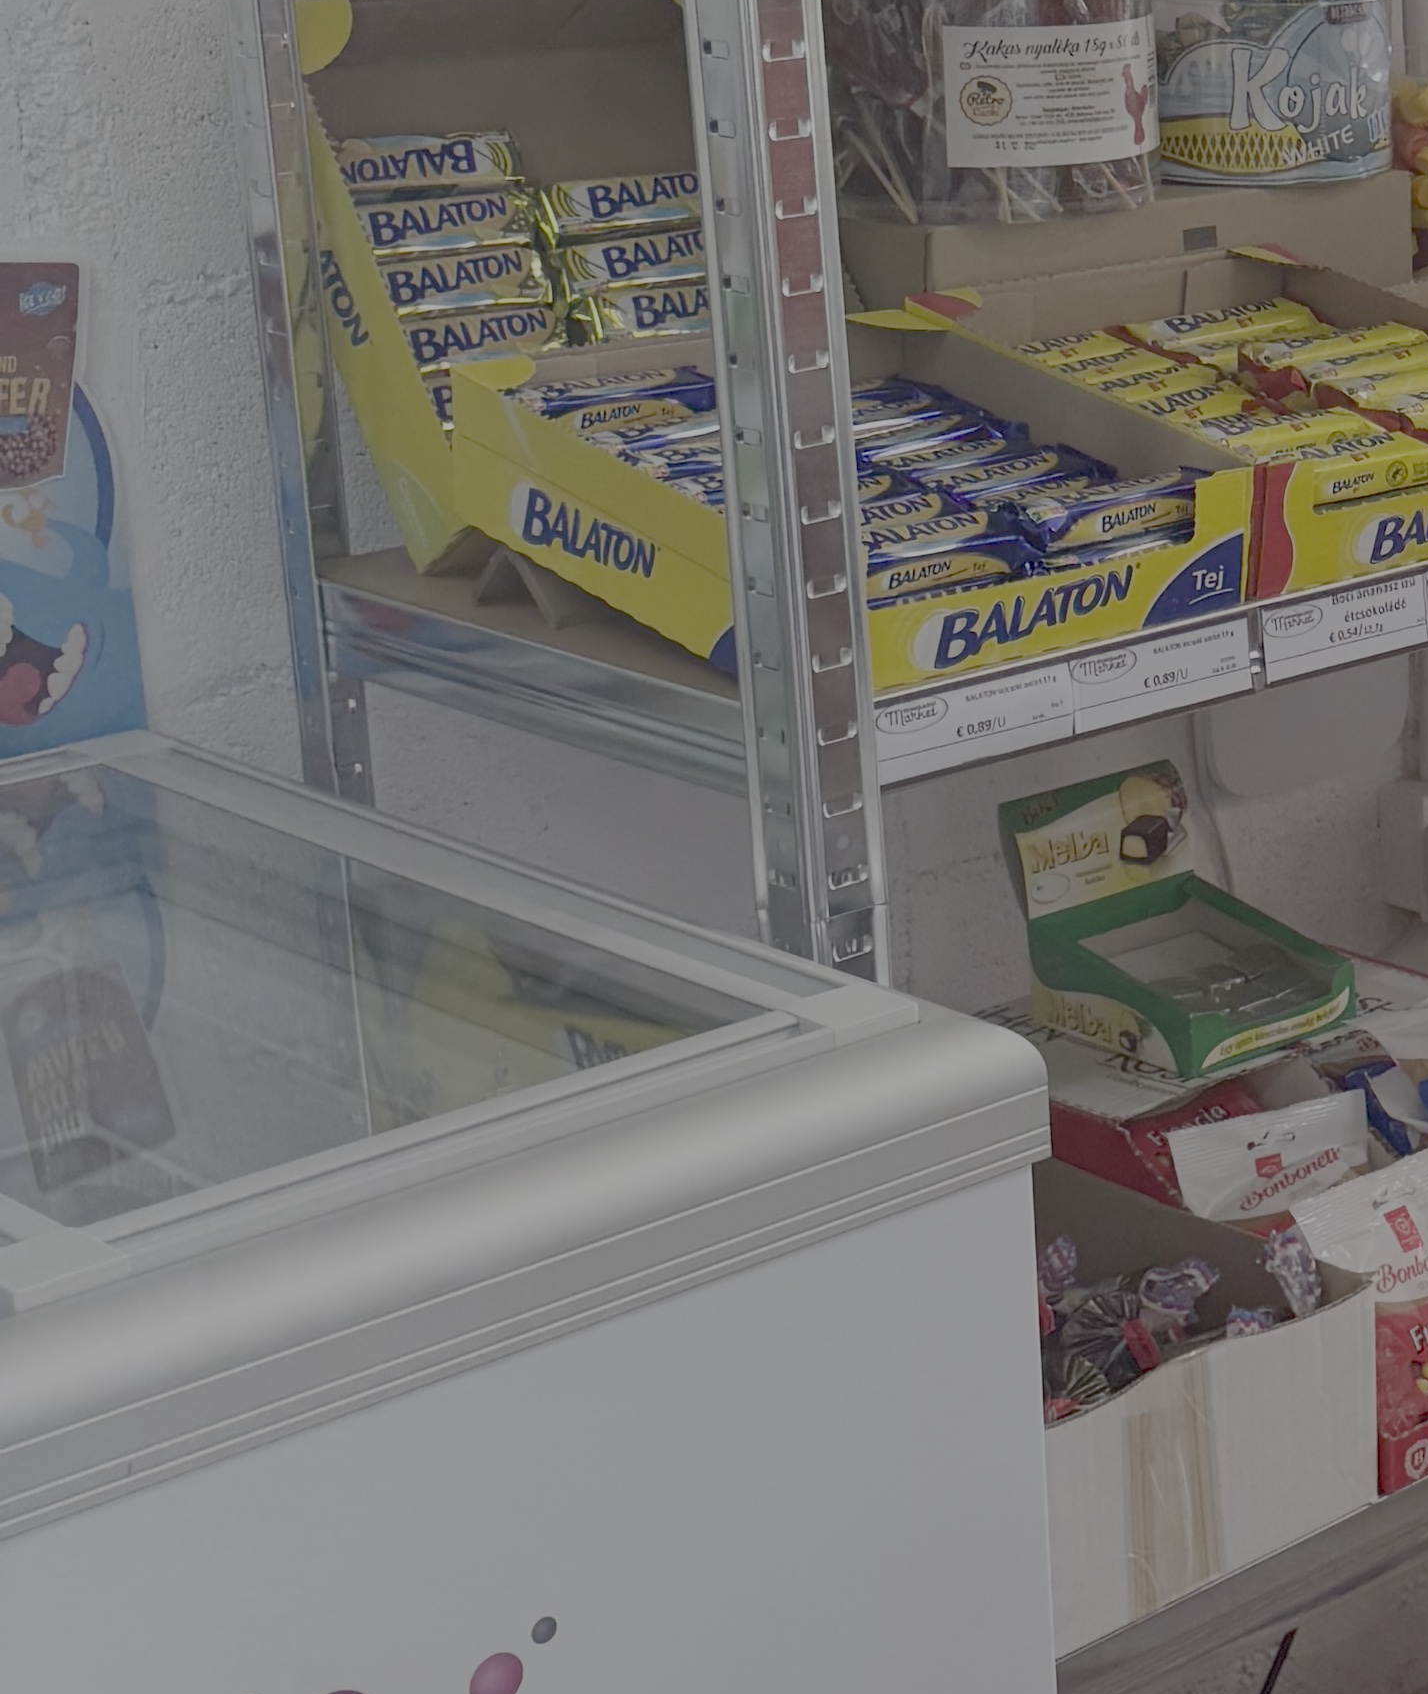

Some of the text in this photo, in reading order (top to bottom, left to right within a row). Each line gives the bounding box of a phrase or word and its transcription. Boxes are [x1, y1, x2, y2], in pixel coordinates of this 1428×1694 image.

[963, 40, 1021, 63] Kakas
[1229, 46, 1368, 134] Kojak
[1281, 123, 1355, 168] WHITE
[588, 172, 701, 218] BALATO
[369, 195, 508, 248] BALATON
[386, 249, 523, 305] BALATON
[409, 307, 549, 365] BALATON
[1168, 295, 1279, 335] BALATON
[580, 403, 642, 429] BALATON
[523, 488, 657, 580] BALATON
[1100, 502, 1157, 534] BALATON
[887, 559, 953, 590] BALATON
[933, 563, 1226, 670] BALATON Tej
